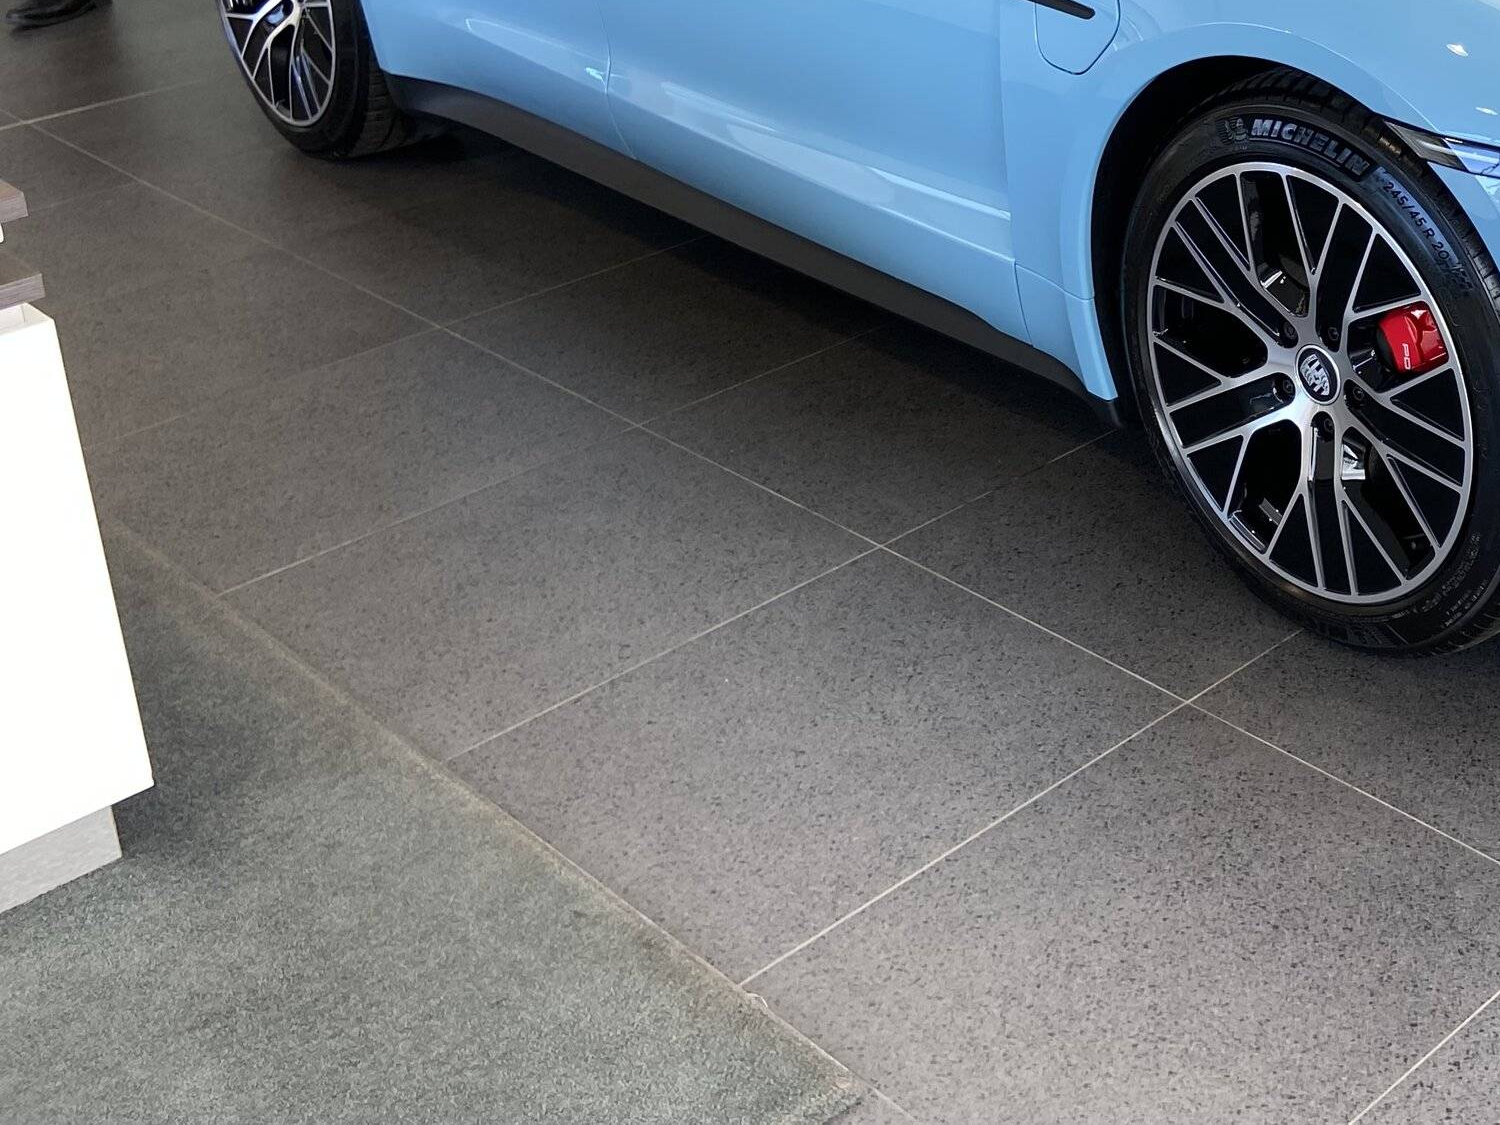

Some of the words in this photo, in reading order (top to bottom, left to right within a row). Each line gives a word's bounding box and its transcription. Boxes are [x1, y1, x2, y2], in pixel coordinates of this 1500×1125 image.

[1250, 118, 1371, 176] MICHELIN
[1383, 181, 1428, 227] 245/45
[1422, 227, 1436, 239] R
[1431, 241, 1450, 260] 20
